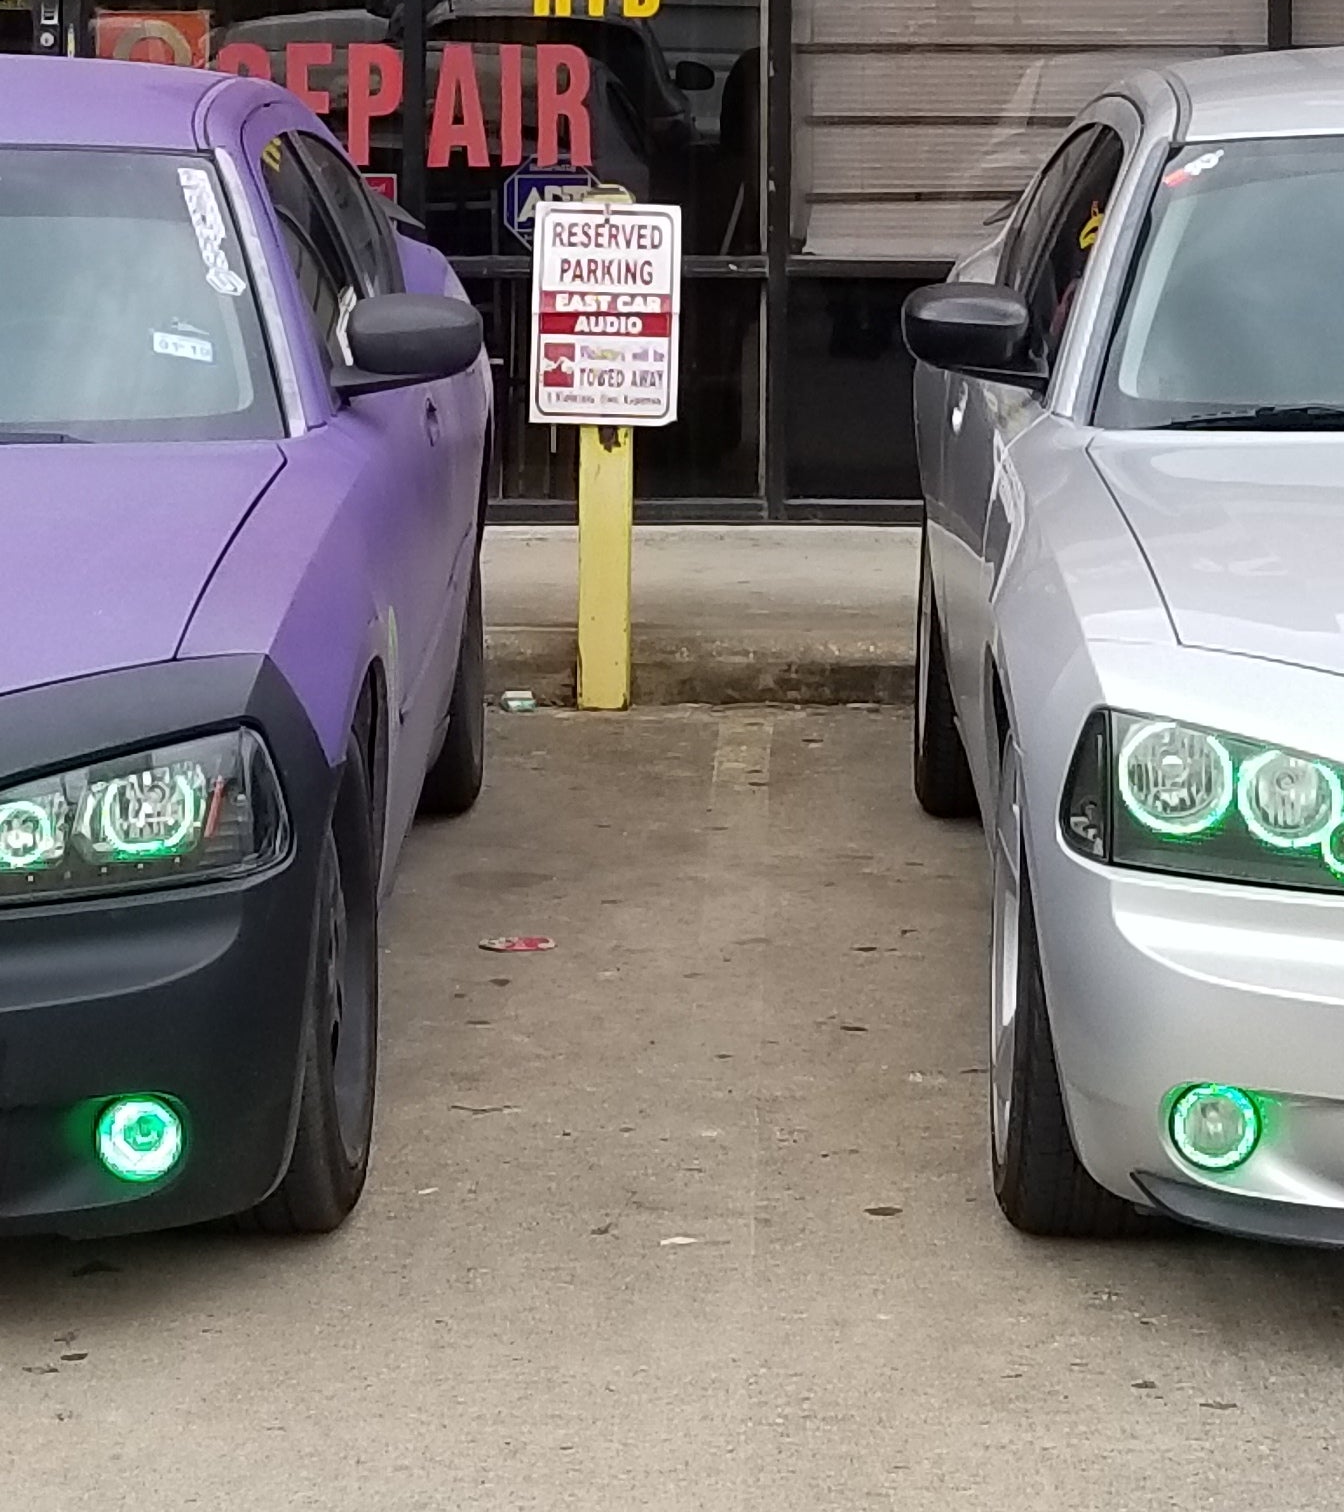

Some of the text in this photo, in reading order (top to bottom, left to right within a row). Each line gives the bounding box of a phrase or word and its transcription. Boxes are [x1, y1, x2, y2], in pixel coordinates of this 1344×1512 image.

[552, 222, 663, 249] RESERVED
[559, 258, 653, 285] PARKING
[555, 294, 661, 312] EAST CAR
[574, 316, 643, 334] AUDIO
[630, 368, 664, 388] AWAY
